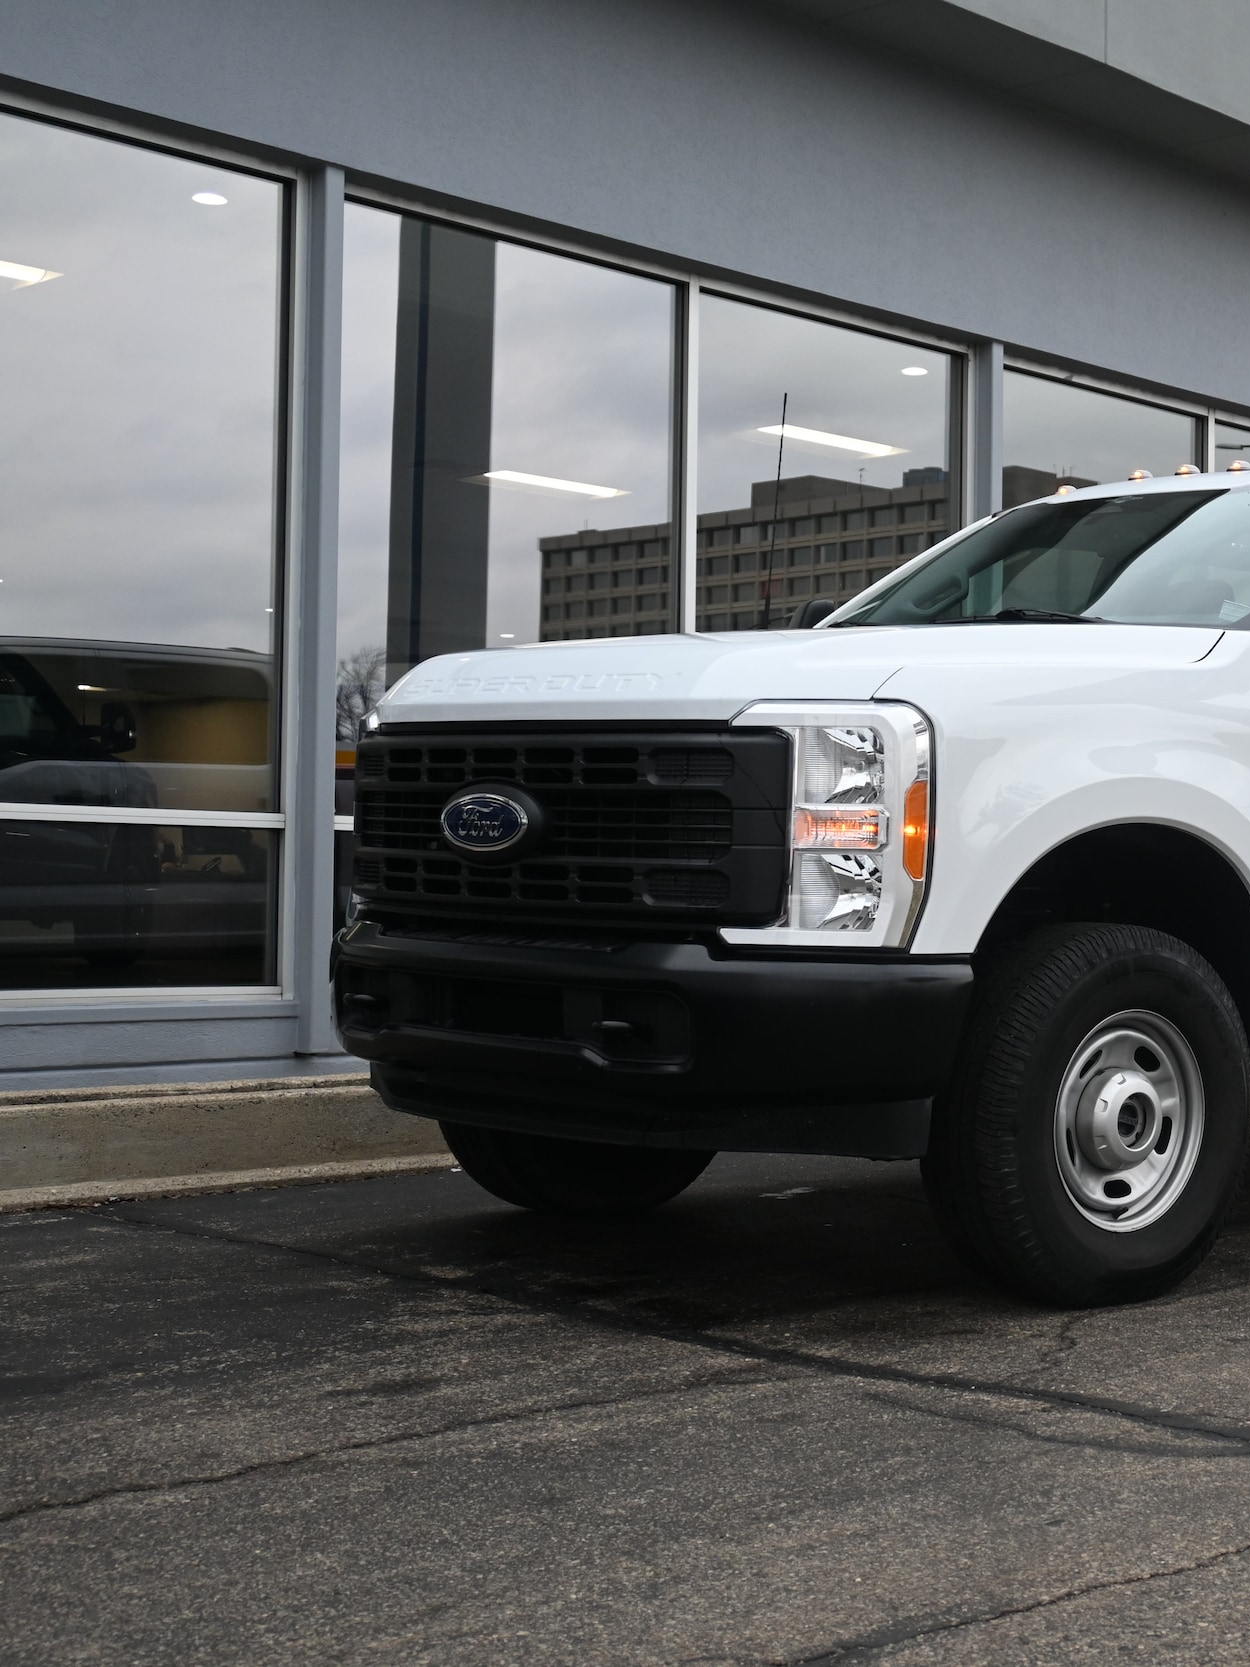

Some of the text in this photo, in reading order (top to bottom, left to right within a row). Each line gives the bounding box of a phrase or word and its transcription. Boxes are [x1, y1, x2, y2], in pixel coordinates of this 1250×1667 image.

[404, 672, 664, 697] SUPER DUTY
[458, 805, 504, 837] Ford
